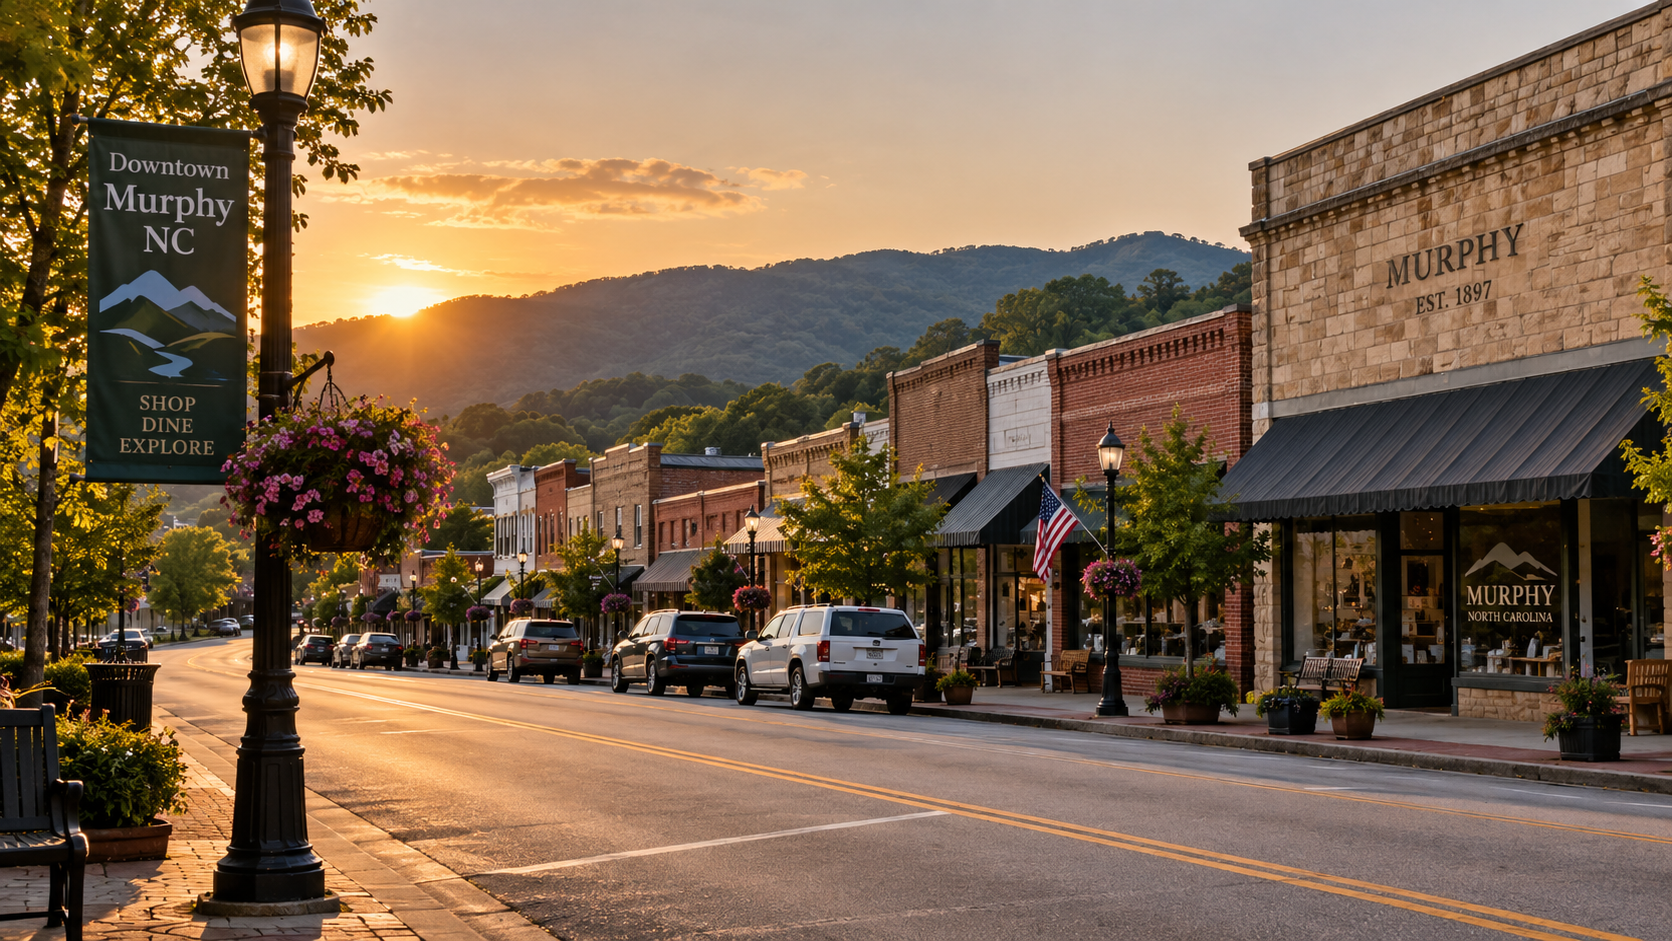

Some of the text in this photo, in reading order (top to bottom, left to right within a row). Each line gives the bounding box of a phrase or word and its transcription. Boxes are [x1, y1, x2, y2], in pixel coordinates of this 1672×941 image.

[109, 152, 229, 180] Downtown
[104, 183, 234, 227] Murphy
[143, 226, 195, 255] NC
[1386, 223, 1524, 289] MURPHY
[1415, 280, 1493, 315] EST. 1897
[139, 395, 196, 412] SHOP
[142, 417, 193, 434] DINE
[119, 438, 215, 456] EXPLORE
[1466, 584, 1555, 606] MURPHY
[1467, 611, 1553, 623] NORTH CAROLINA
